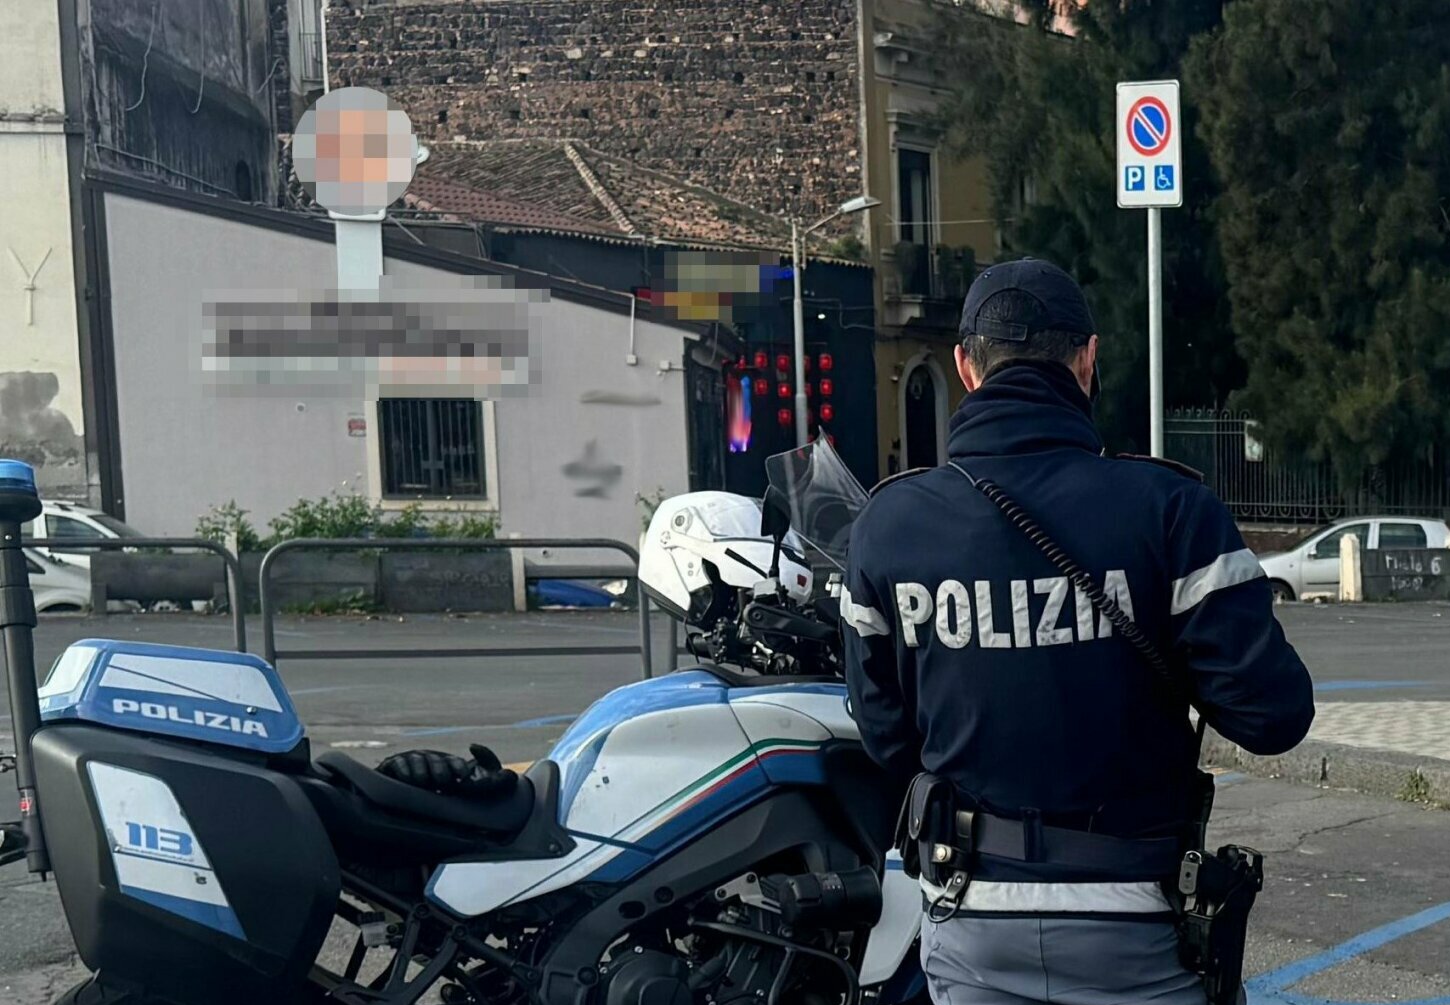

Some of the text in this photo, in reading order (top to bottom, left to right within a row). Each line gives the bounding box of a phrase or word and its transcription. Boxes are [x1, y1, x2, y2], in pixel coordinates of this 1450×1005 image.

[1128, 167, 1142, 190] P
[895, 569, 1135, 650] POLIZIA
[112, 698, 268, 738] POLIZIA
[125, 821, 193, 856] 113
